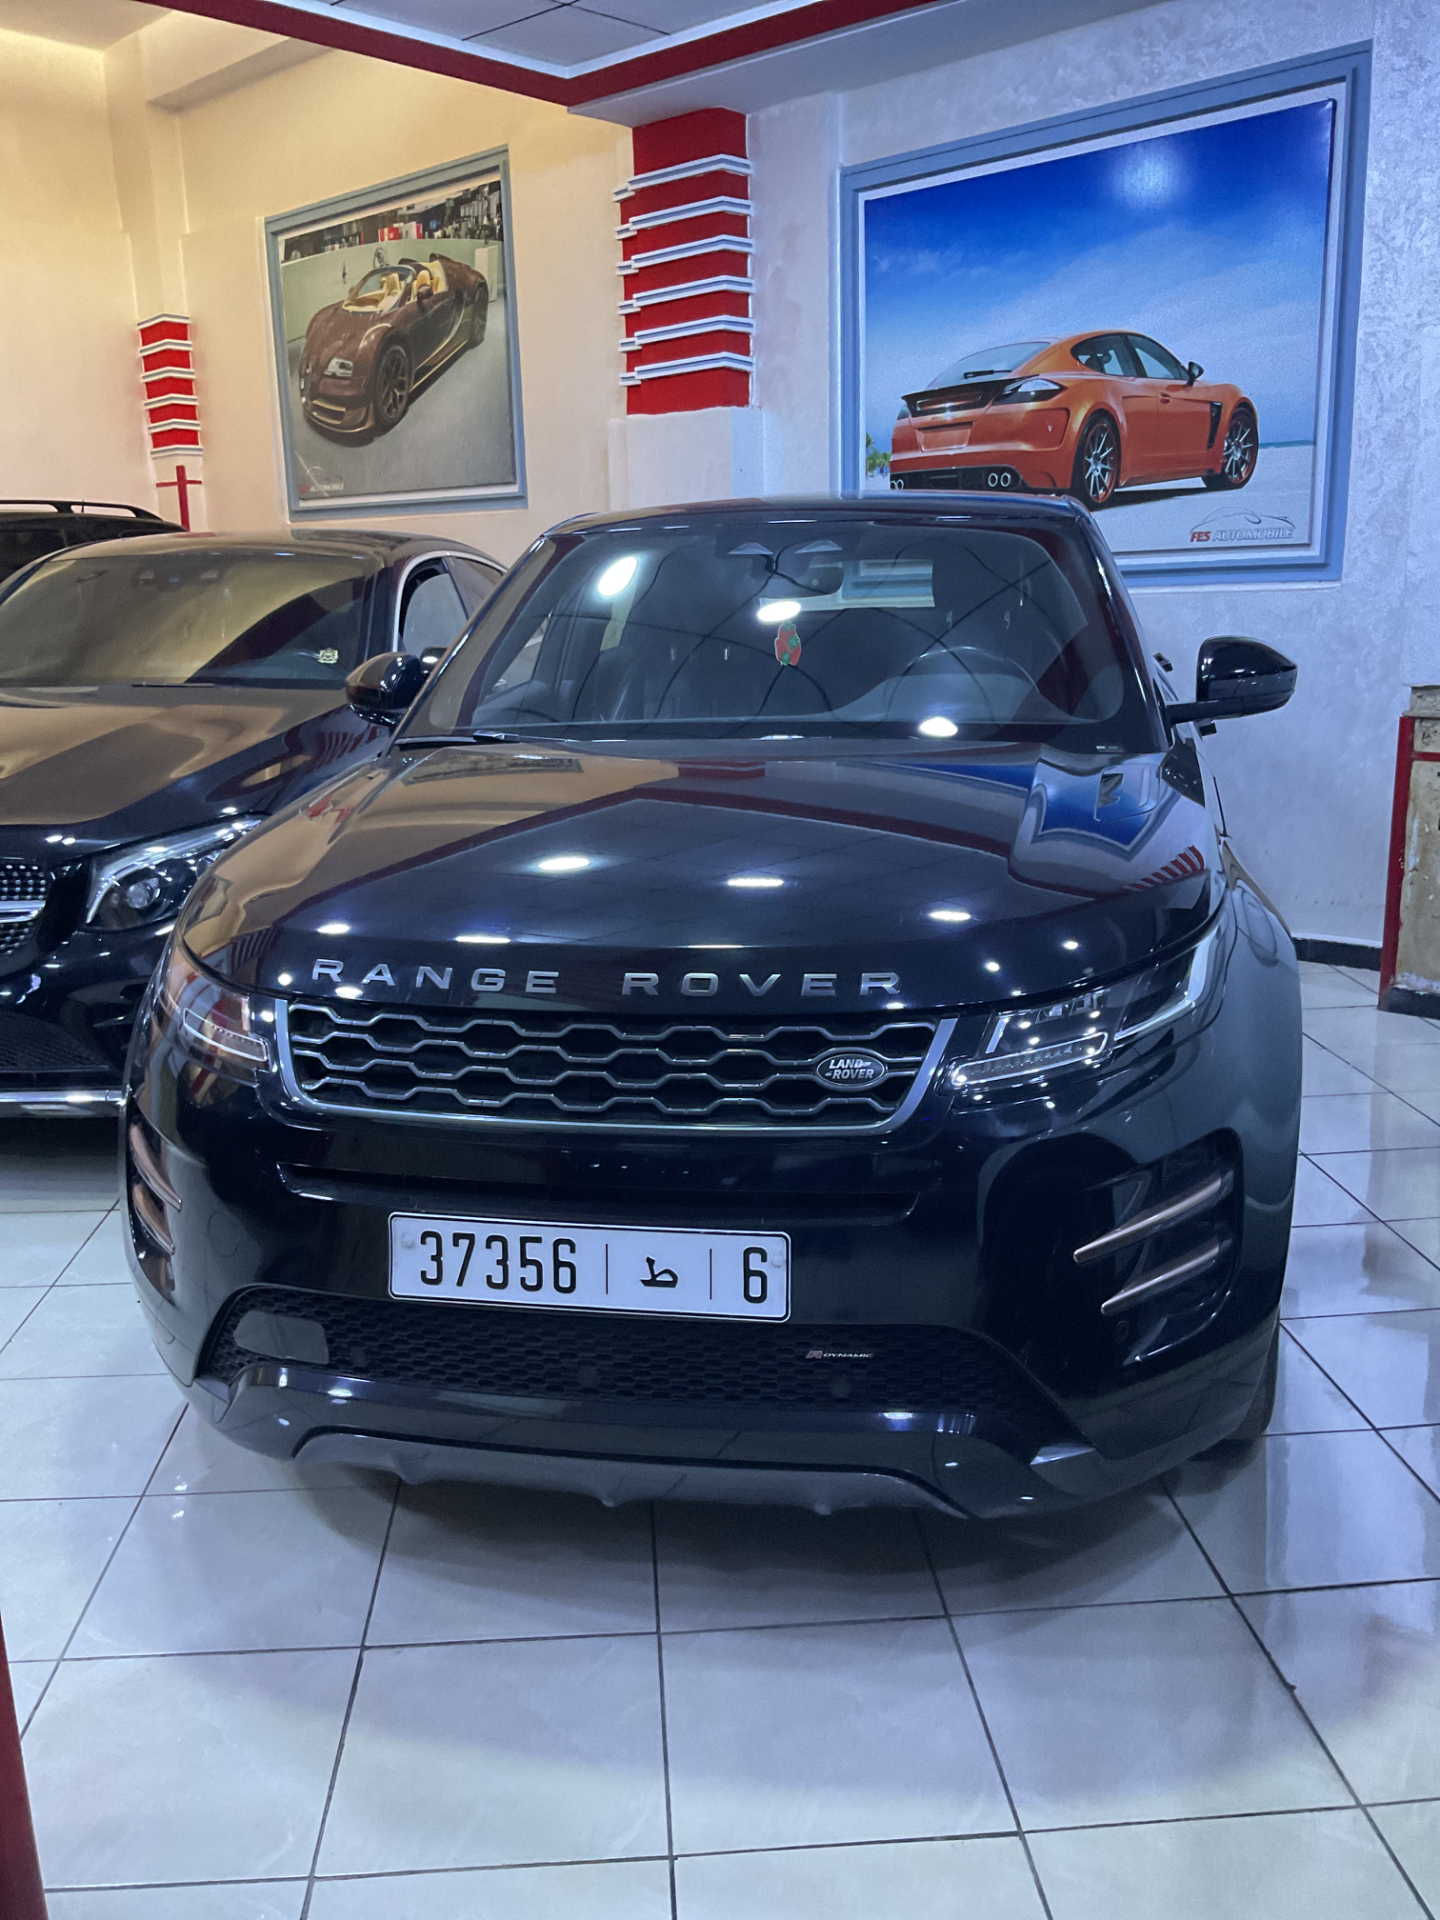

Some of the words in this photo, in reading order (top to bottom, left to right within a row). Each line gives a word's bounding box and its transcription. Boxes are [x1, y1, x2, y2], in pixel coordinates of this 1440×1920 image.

[1190, 530, 1212, 542] FES
[1212, 527, 1293, 542] AUTOMOBILE
[311, 958, 559, 994] RANGE
[621, 972, 900, 997] ROVER
[828, 1059, 865, 1070] LAND
[831, 1068, 875, 1080] ROVER
[419, 1230, 577, 1294] 37356
[640, 1256, 679, 1289] ط
[742, 1246, 768, 1304] 6
